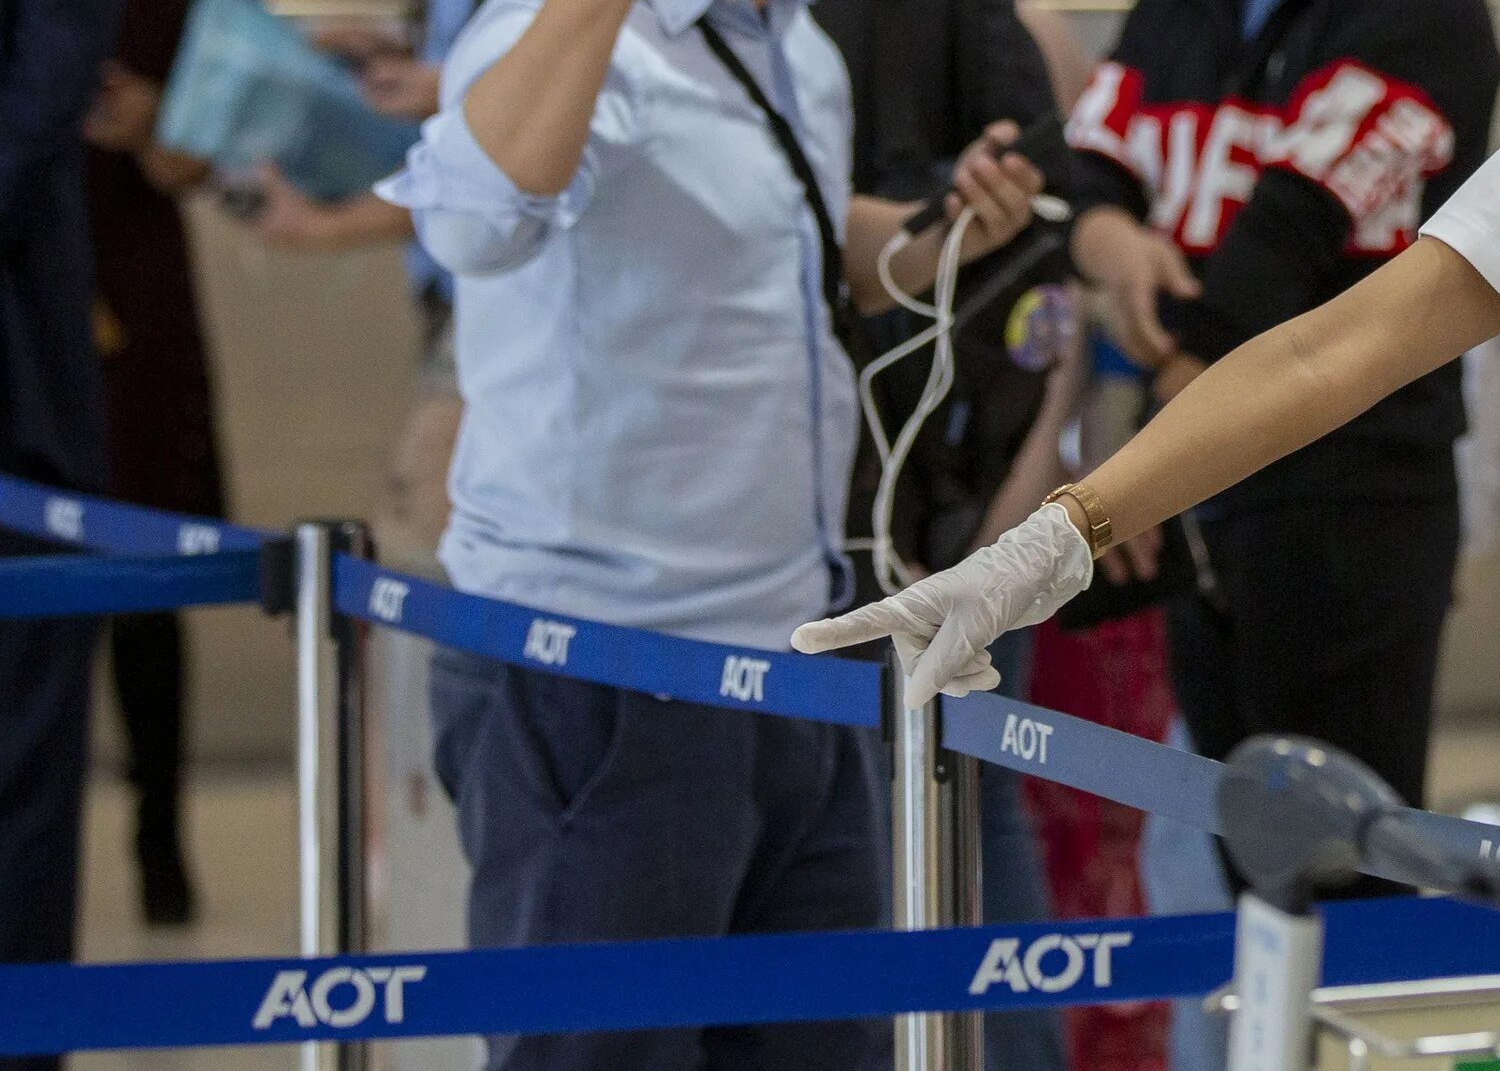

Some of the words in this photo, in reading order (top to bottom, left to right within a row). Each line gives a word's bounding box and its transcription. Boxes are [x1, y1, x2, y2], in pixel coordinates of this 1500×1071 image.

[524, 619, 577, 666] AOT
[720, 656, 771, 703] AOT
[1001, 714, 1054, 763] AOT
[970, 933, 1132, 995] AOT
[253, 966, 427, 1029] AOT
